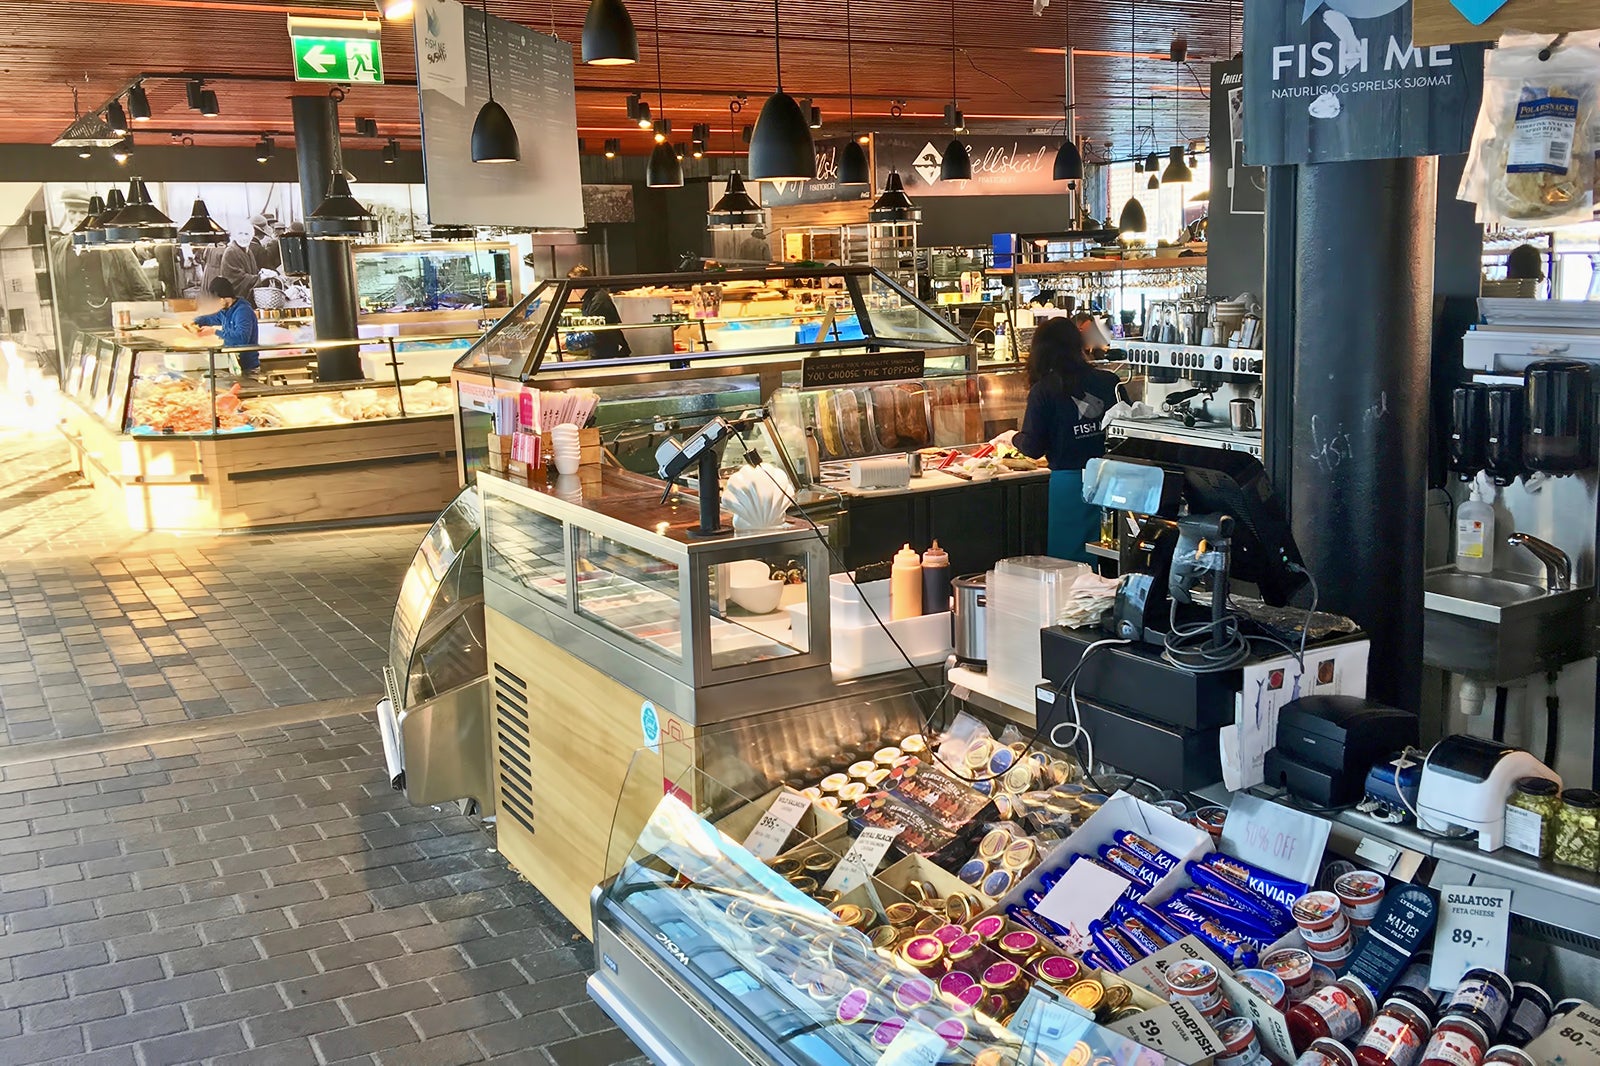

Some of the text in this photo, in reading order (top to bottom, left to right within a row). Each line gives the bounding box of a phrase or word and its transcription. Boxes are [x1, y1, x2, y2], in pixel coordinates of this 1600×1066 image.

[1272, 34, 1452, 80] FISH ME
[1272, 74, 1452, 99] NATURLIG OG SPRELSK SJØMAT
[808, 366, 920, 380] YOU CHOOSE THE TOPPING
[1073, 422, 1096, 436] FISH
[1274, 832, 1296, 860] OFF
[1249, 877, 1296, 908] KAVIAR
[1447, 894, 1503, 908] SALATOST
[1452, 907, 1496, 918] FETA CHEESE
[1385, 913, 1420, 939] MATJES
[1452, 928, 1484, 948] 89,-
[1180, 943, 1198, 958] COD
[1140, 1019, 1164, 1046] 59,-
[1170, 1001, 1216, 1056] LUMPFISH
[1172, 1021, 1190, 1042] CAVIAR
